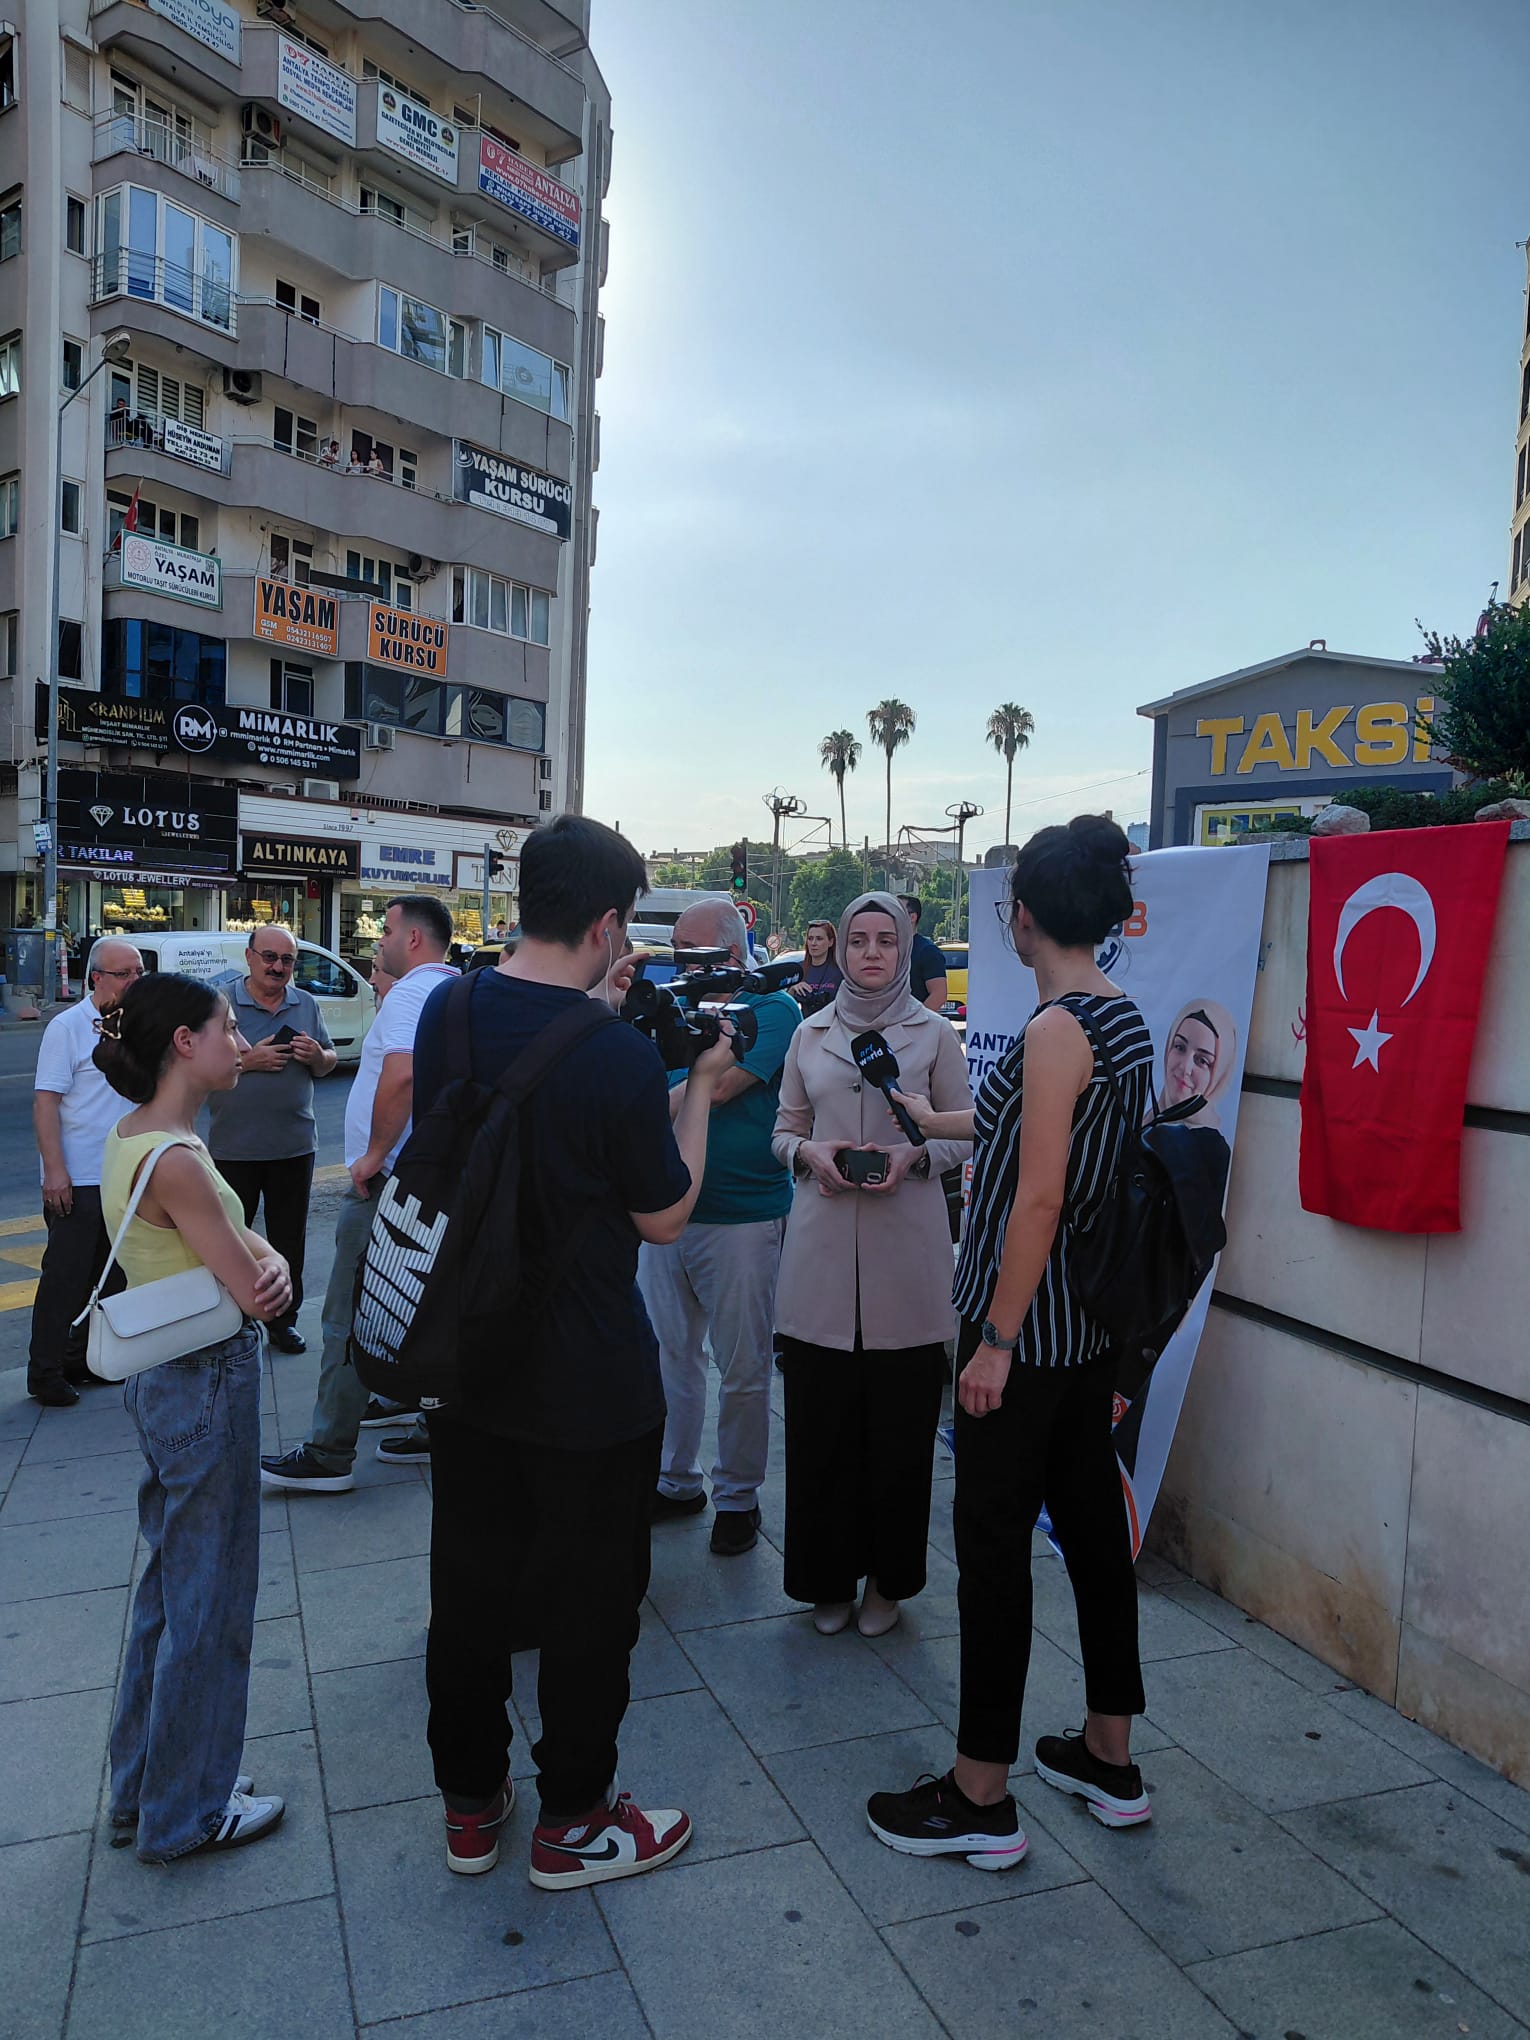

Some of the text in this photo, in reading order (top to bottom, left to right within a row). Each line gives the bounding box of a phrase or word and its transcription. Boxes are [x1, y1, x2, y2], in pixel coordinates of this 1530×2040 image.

[282, 63, 303, 83] SOSYAL
[283, 55, 310, 78] ANTALYA
[310, 73, 331, 91] TEMPO
[381, 111, 416, 136] GAZETECİLER
[401, 103, 438, 138] GMC
[495, 165, 566, 213] www.07haber.com.tr
[496, 184, 532, 209] WHATSAPP
[535, 175, 577, 212] ANTALYA
[519, 206, 538, 221] 774
[542, 219, 556, 231] 74
[558, 230, 572, 240] 47
[167, 429, 192, 445] HÜSEYİN
[176, 424, 214, 443] DİŞ HEKİMİ
[471, 451, 571, 505] YAŞAM SÜRÜCÜ
[484, 478, 545, 514] KURSU
[154, 545, 173, 555] ANTALYA
[154, 550, 168, 560] ÖZEL
[155, 557, 215, 588] YAŞAM
[127, 571, 216, 602] MOTORLU TAŞIT SÜRÜCÜLERİ KURSU
[261, 581, 335, 630] YAŞAM
[261, 619, 278, 630] GSM
[261, 628, 275, 637] TEL
[374, 611, 445, 648] SÜRÜCÜ
[379, 637, 437, 670] KURSU
[179, 716, 212, 739] RM
[1196, 696, 1435, 776] TAKSİ
[283, 738, 294, 748] RM
[295, 740, 323, 752] Partners
[275, 756, 290, 765] 506
[289, 758, 301, 767] 145
[302, 759, 311, 768] 53
[311, 761, 318, 769] 11
[122, 806, 200, 831] LOTUS
[338, 824, 354, 833] 1997
[68, 845, 134, 862] TAKILAR
[252, 842, 348, 867] ALTINKAYA
[379, 845, 436, 866] EMRE
[103, 871, 135, 882] LOTUS
[136, 874, 191, 887] JEWELLERY
[361, 867, 451, 885] KUYUMCULUK
[178, 949, 213, 957] Antalya'yı
[179, 958, 228, 967] dönüştürmeye
[859, 1047, 884, 1067] world
[353, 1174, 450, 1364] NIKE
